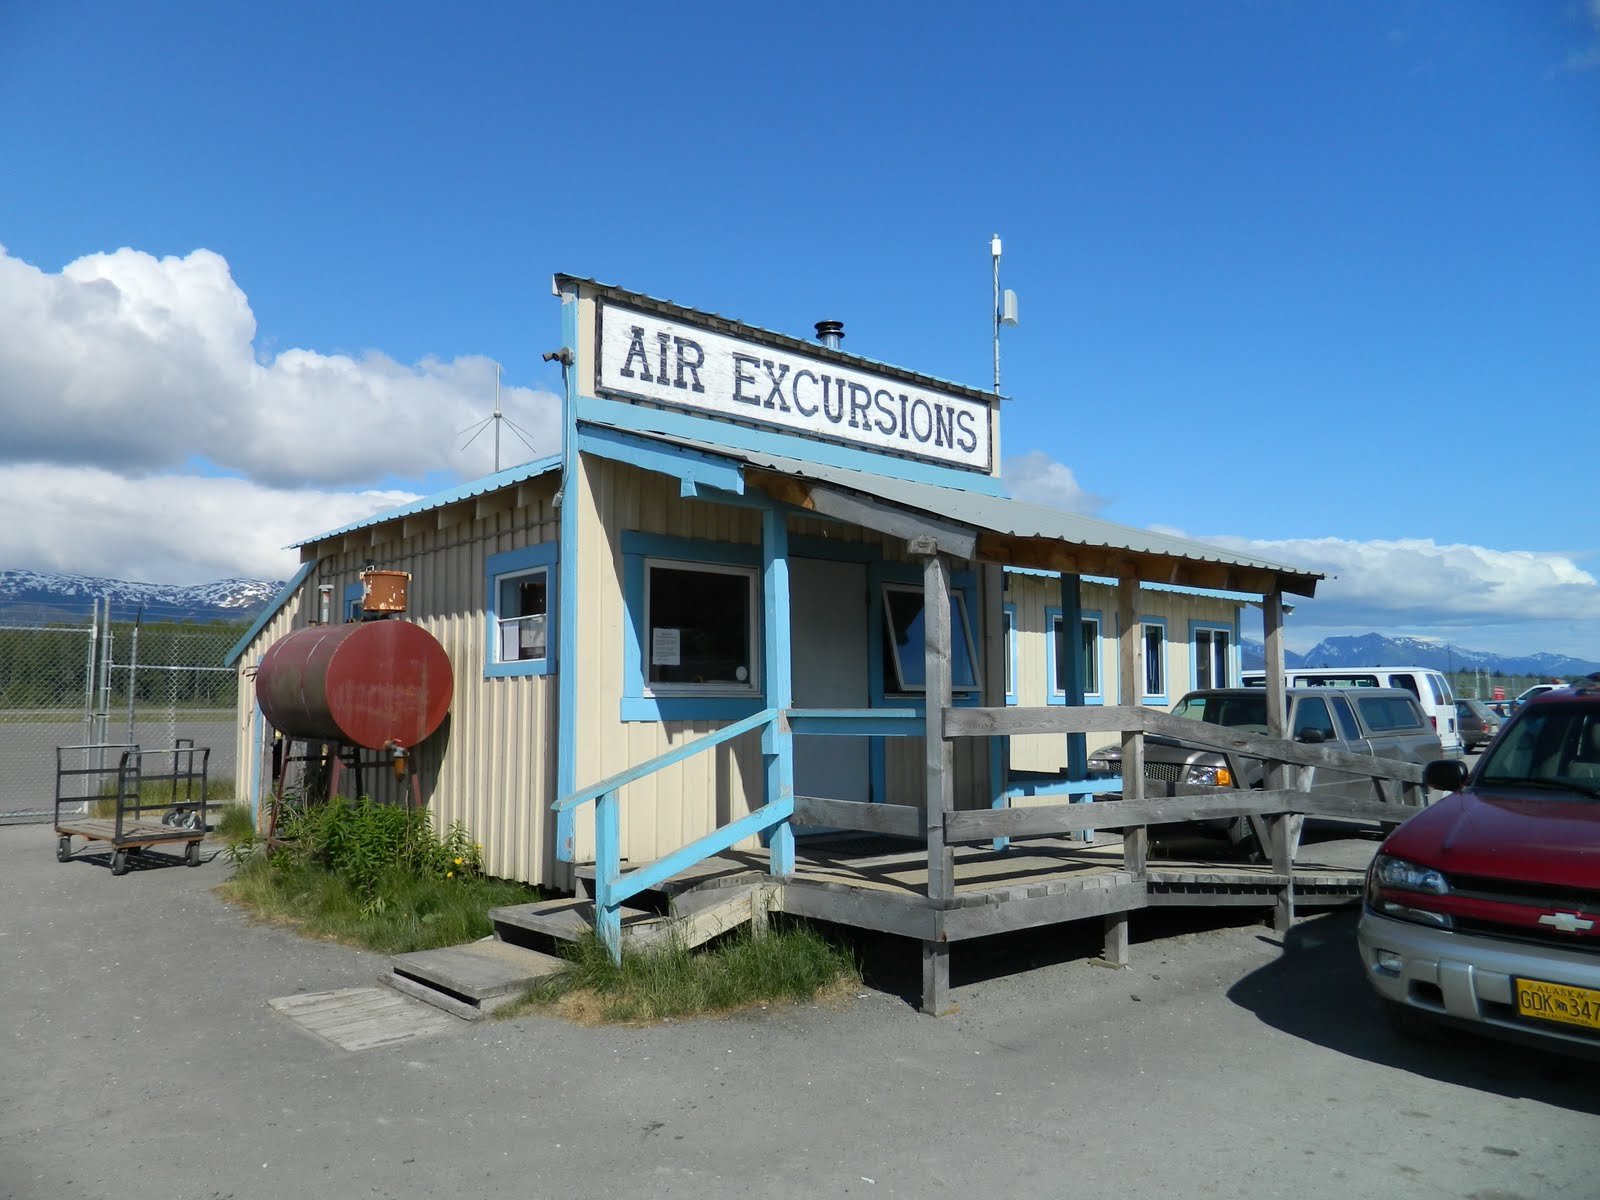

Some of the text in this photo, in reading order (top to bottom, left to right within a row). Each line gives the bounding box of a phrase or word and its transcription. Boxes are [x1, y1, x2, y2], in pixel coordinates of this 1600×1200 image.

[620, 325, 977, 453] AIR EXCURSIONS
[1536, 985, 1584, 999] ALASKA
